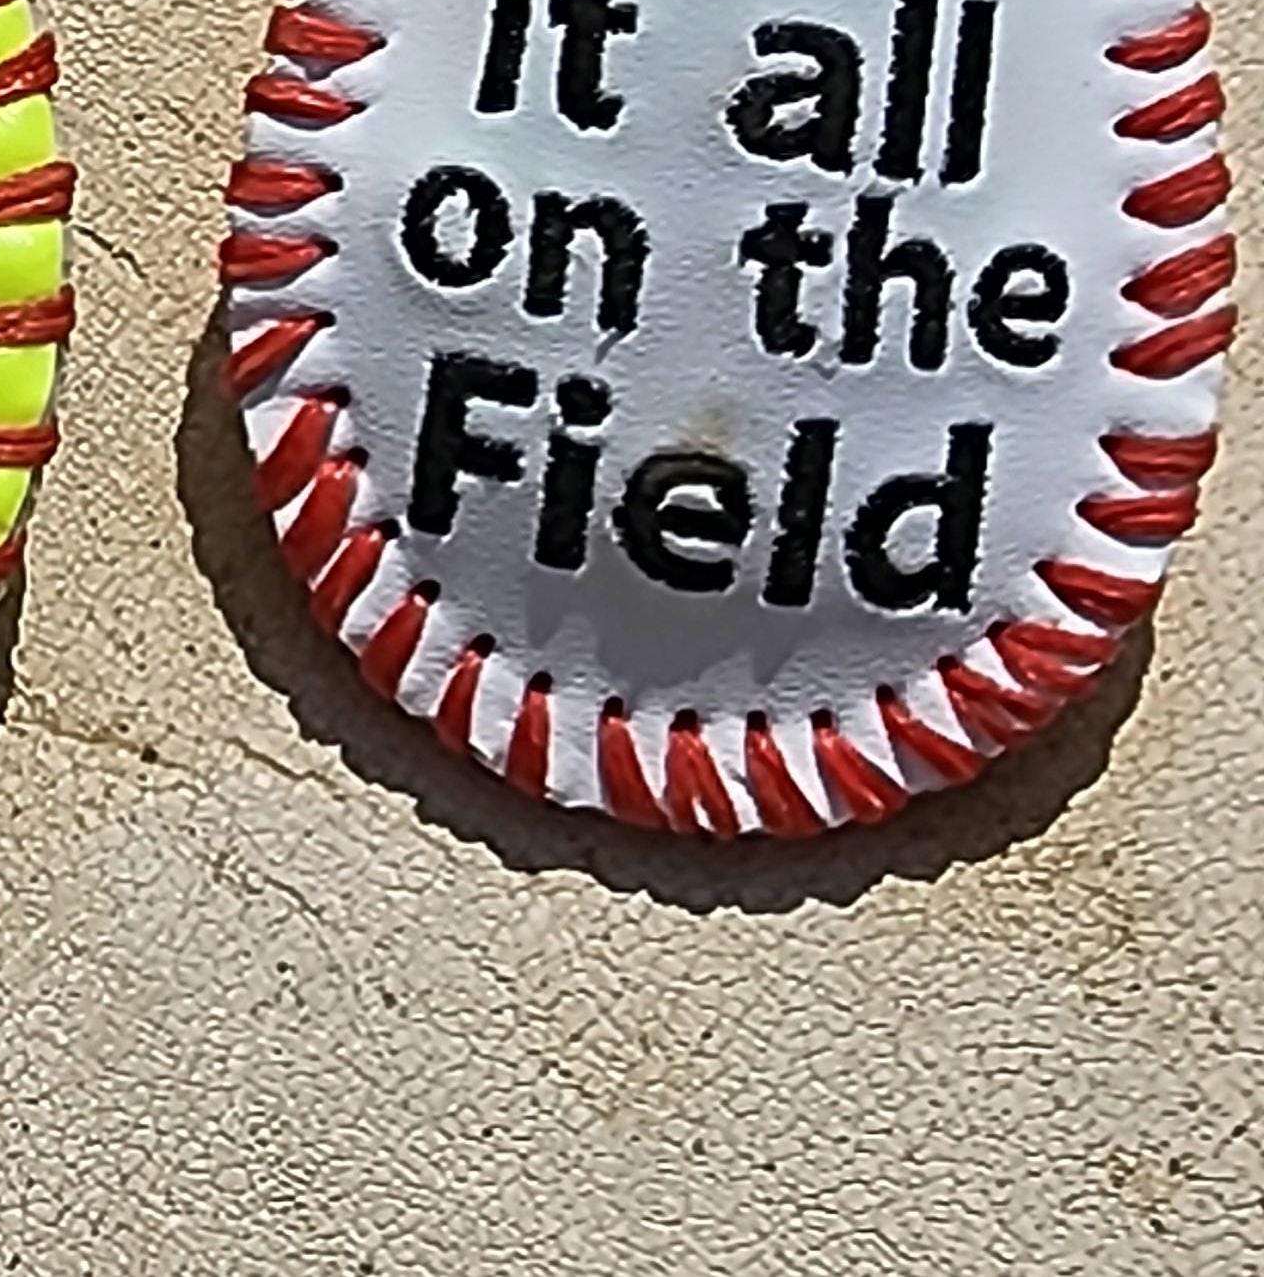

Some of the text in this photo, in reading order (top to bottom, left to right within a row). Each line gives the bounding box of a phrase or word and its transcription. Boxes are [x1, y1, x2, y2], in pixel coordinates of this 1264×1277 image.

[400, 165, 1069, 371] on the
[405, 350, 995, 616] Field
